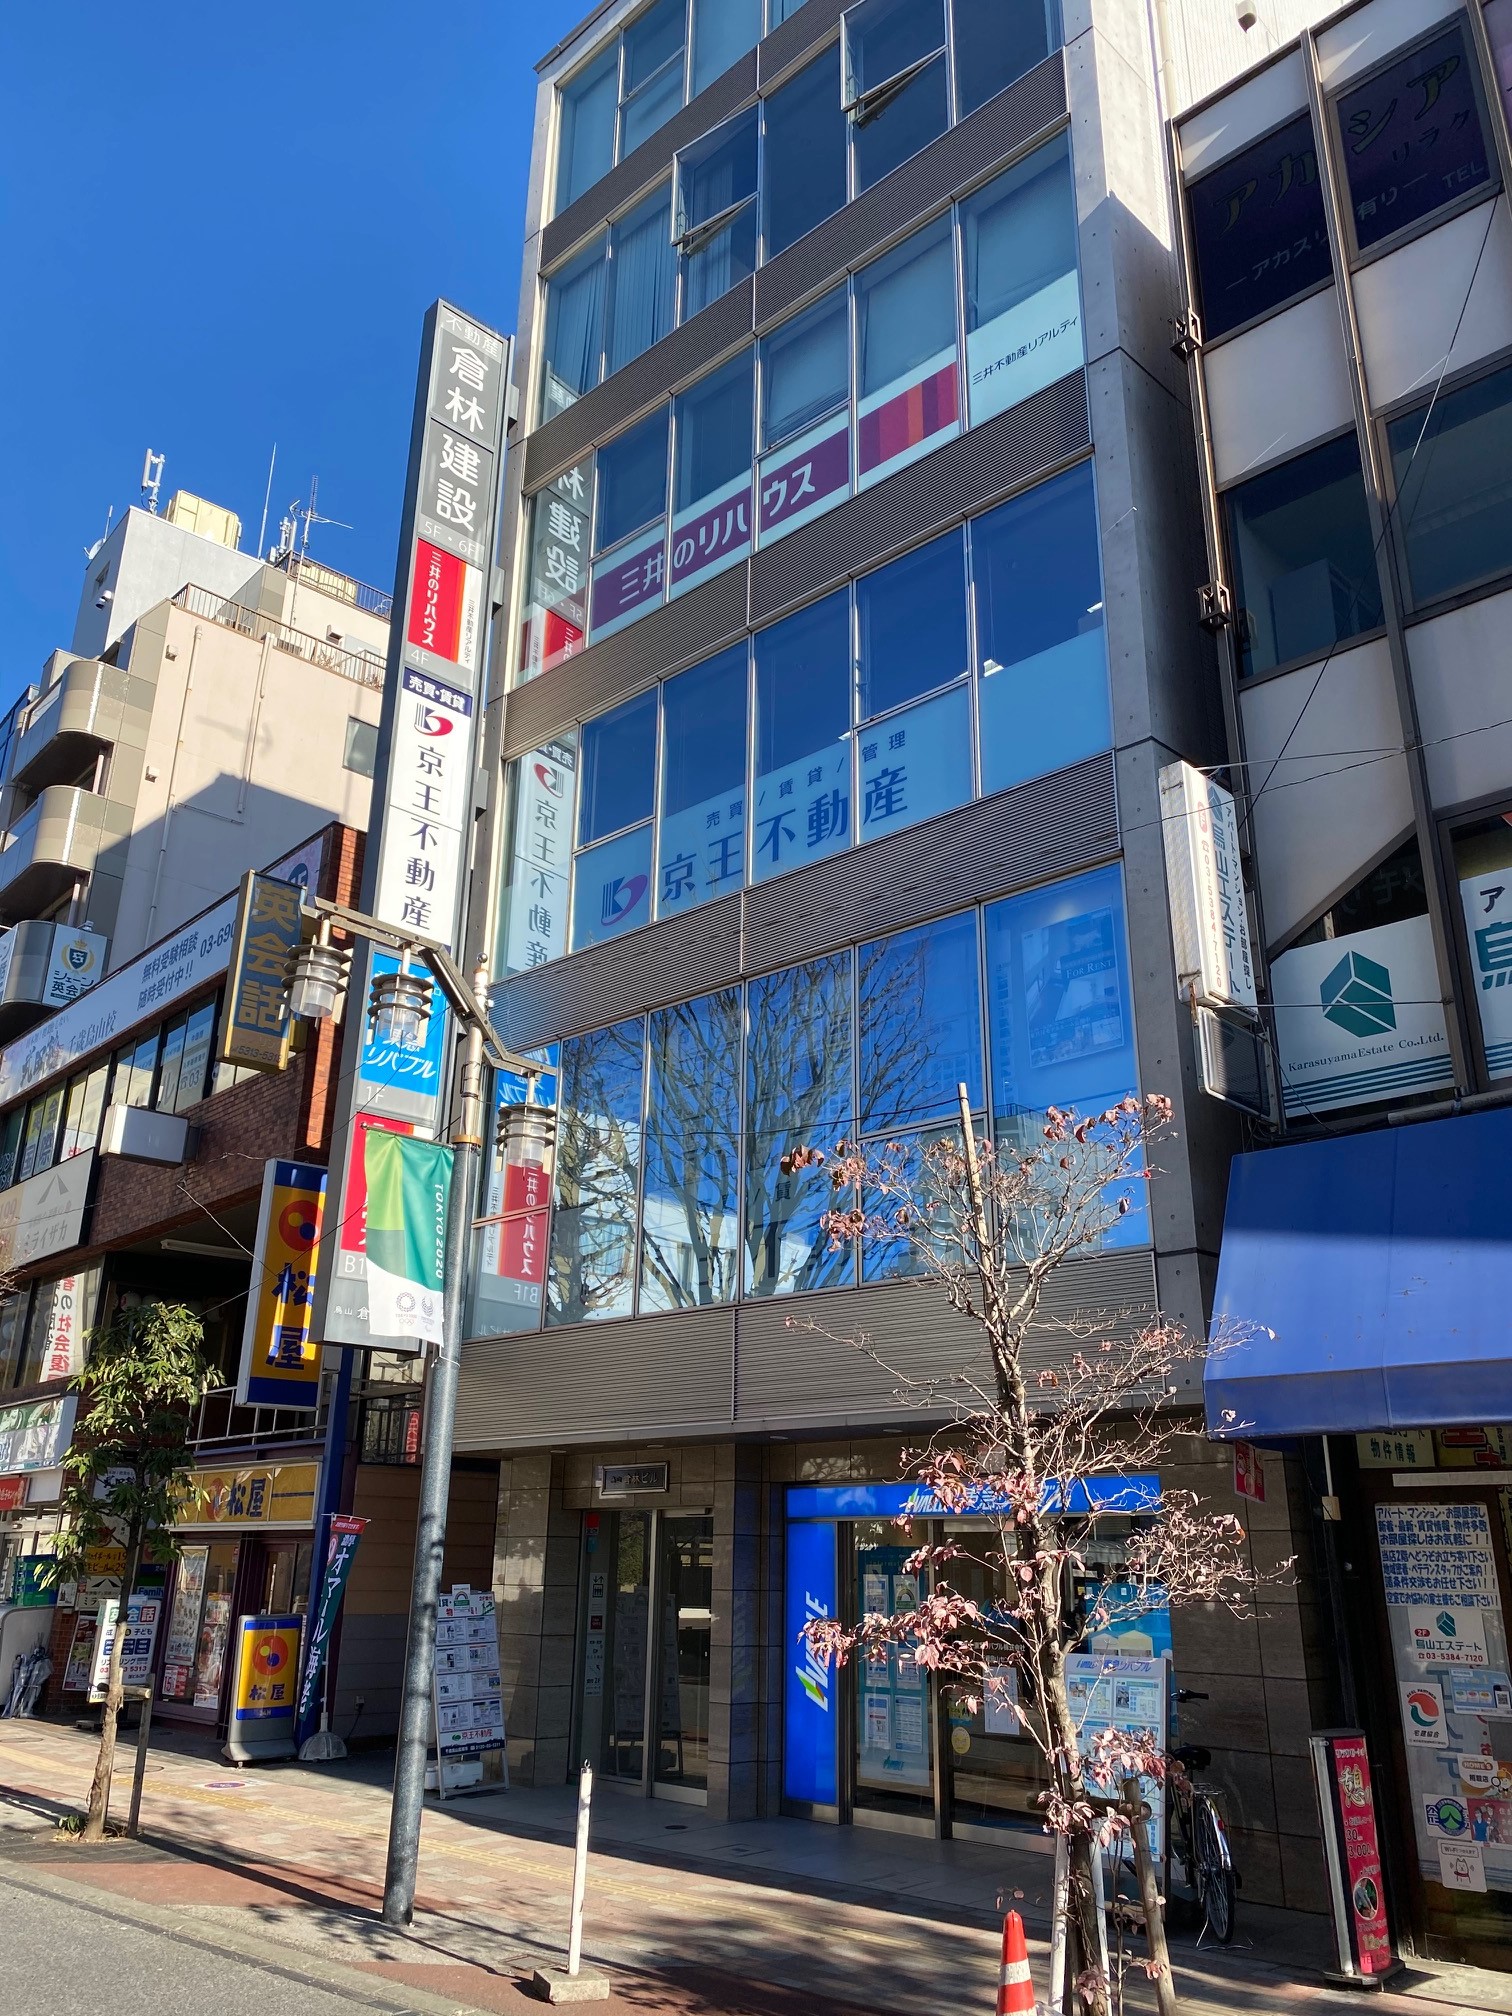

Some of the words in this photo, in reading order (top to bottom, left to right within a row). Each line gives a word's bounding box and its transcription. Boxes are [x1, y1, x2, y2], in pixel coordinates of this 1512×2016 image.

[1442, 160, 1485, 192] TEL
[445, 312, 498, 358] 不動産
[972, 316, 1078, 386] 三井不動産リアルティ
[436, 345, 489, 533] 倉林建設
[619, 461, 815, 605] 三井のリハウス
[421, 551, 443, 648] 三井のリハウス
[410, 649, 430, 667] 4F
[408, 673, 467, 712] 売買・賃貸
[400, 745, 447, 931] 京王不動産
[661, 765, 908, 902] 京王不動産
[1479, 885, 1506, 914] ア
[237, 881, 301, 1033] 英会話
[53, 969, 95, 988] シェーン
[365, 1045, 439, 1080] リバブル
[365, 1085, 386, 1104] 1F
[434, 1183, 444, 1235] TOKYO
[434, 1238, 444, 1280] 2020
[265, 1262, 313, 1371] 松屋
[1370, 1437, 1416, 1464] 物件情報
[227, 1477, 267, 1517] 松屋
[1375, 1506, 1486, 1519] アパート・マンション・お部屋探し
[1416, 1629, 1428, 1637] 2F
[1426, 1652, 1483, 1663] 03-5384-7120
[248, 1683, 286, 1701] 松屋
[1463, 1761, 1492, 1770] HOME'S
